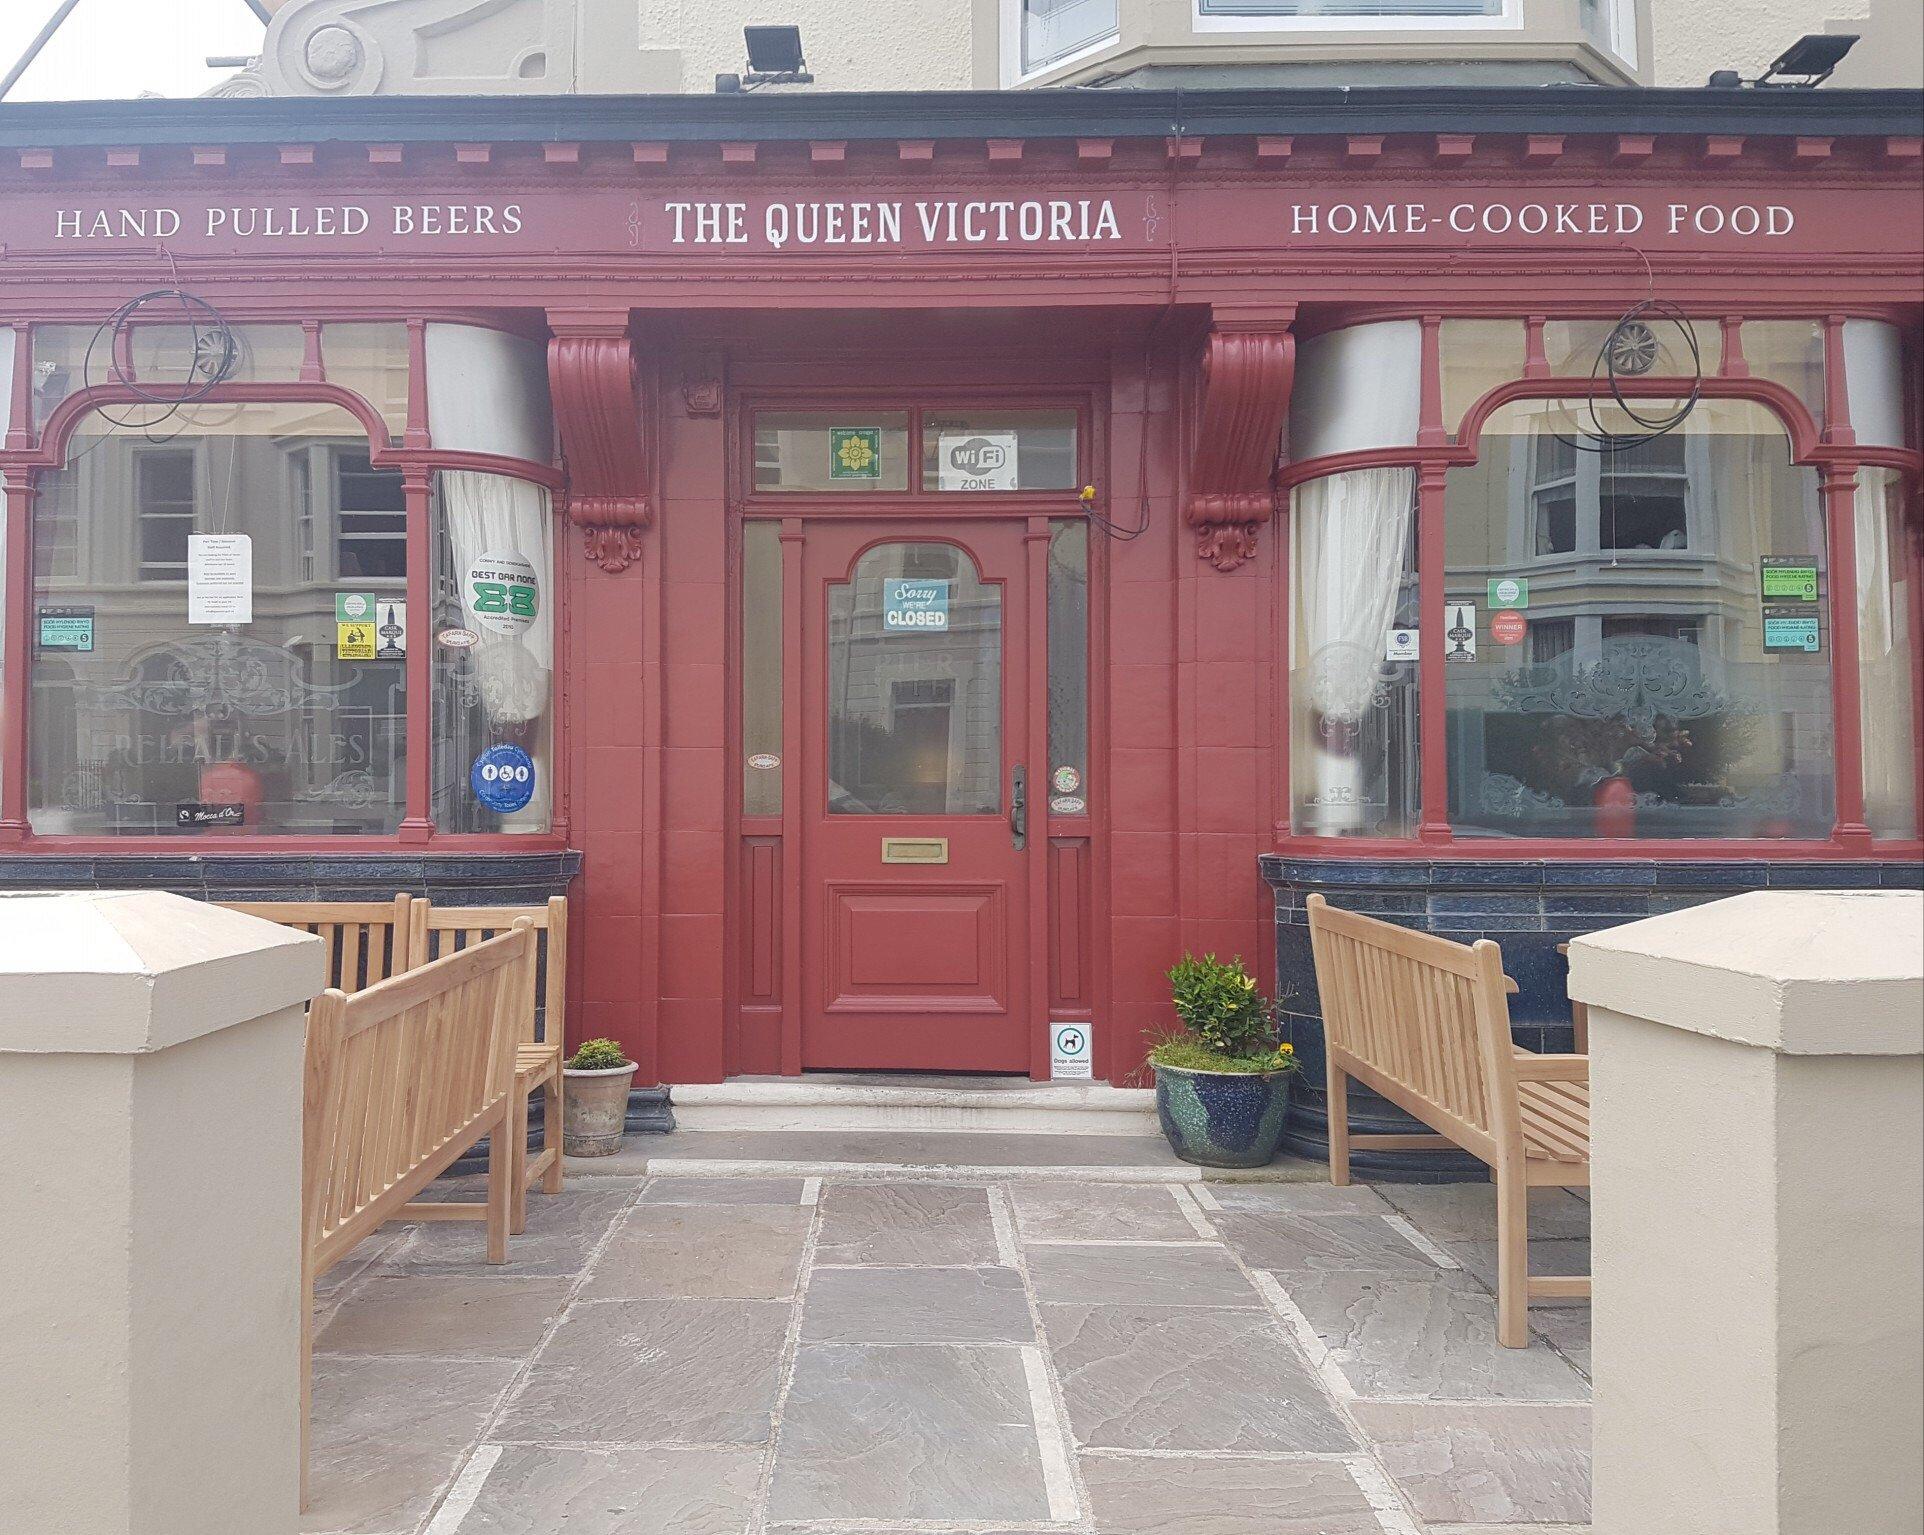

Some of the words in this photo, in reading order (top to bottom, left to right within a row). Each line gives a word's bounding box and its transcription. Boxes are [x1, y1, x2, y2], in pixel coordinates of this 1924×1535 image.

[54, 208, 181, 239] HAND
[205, 205, 371, 237] PULLED
[392, 204, 524, 235] BEERS
[664, 202, 749, 244] THE
[765, 201, 902, 248] QUEEN
[915, 200, 1122, 243] VICTORIA
[1291, 203, 1644, 235] HOME-COOKED
[1667, 204, 1796, 236] FOOD
[960, 478, 996, 490] ZONE
[471, 570, 496, 580] BEST
[498, 572, 515, 582] BAR
[516, 575, 537, 585] NONE
[894, 583, 938, 606] Sorry
[887, 610, 945, 626] CLOSED
[1495, 623, 1523, 631] WINNER
[284, 729, 366, 764] ALES
